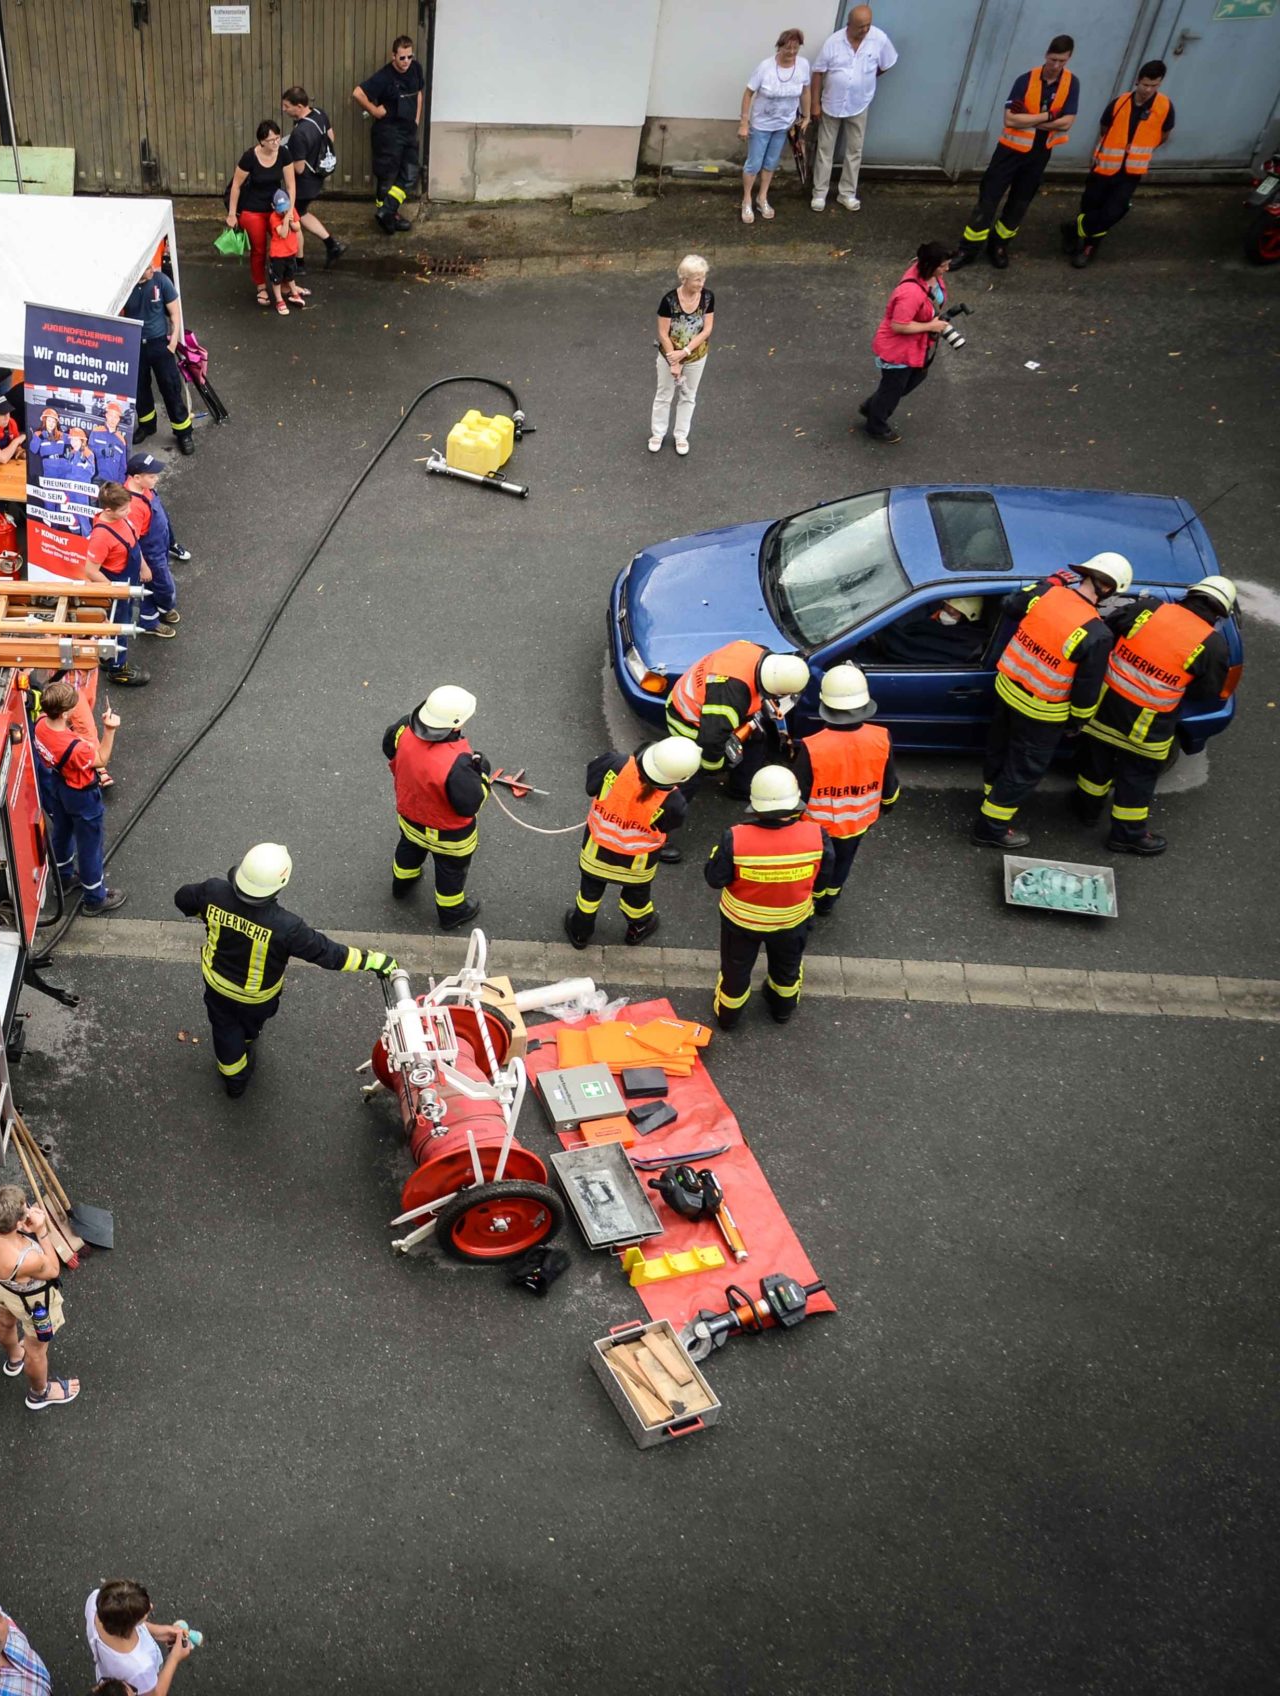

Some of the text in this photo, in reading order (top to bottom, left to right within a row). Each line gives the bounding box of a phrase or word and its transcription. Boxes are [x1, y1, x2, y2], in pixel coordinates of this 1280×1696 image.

[42, 322, 124, 345] JUGENDFEUERWEHR
[66, 336, 99, 349] PLAUEN
[33, 345, 130, 376] Wir machen mit!
[54, 365, 108, 386] Du auch?
[32, 488, 63, 501] HELD SEIN
[42, 479, 96, 494] FREUNDE FINDEN
[31, 507, 72, 523] SPASS HABEN
[67, 503, 96, 516] ANDEREN
[40, 530, 70, 546] KONTAKT
[1014, 628, 1061, 670] EUERWEHR
[1117, 644, 1181, 687] FEUERWEHR
[817, 781, 879, 797] FEUERWEHR
[594, 804, 651, 834] FEUERWEHR
[208, 905, 271, 943] FEUERWEHR
